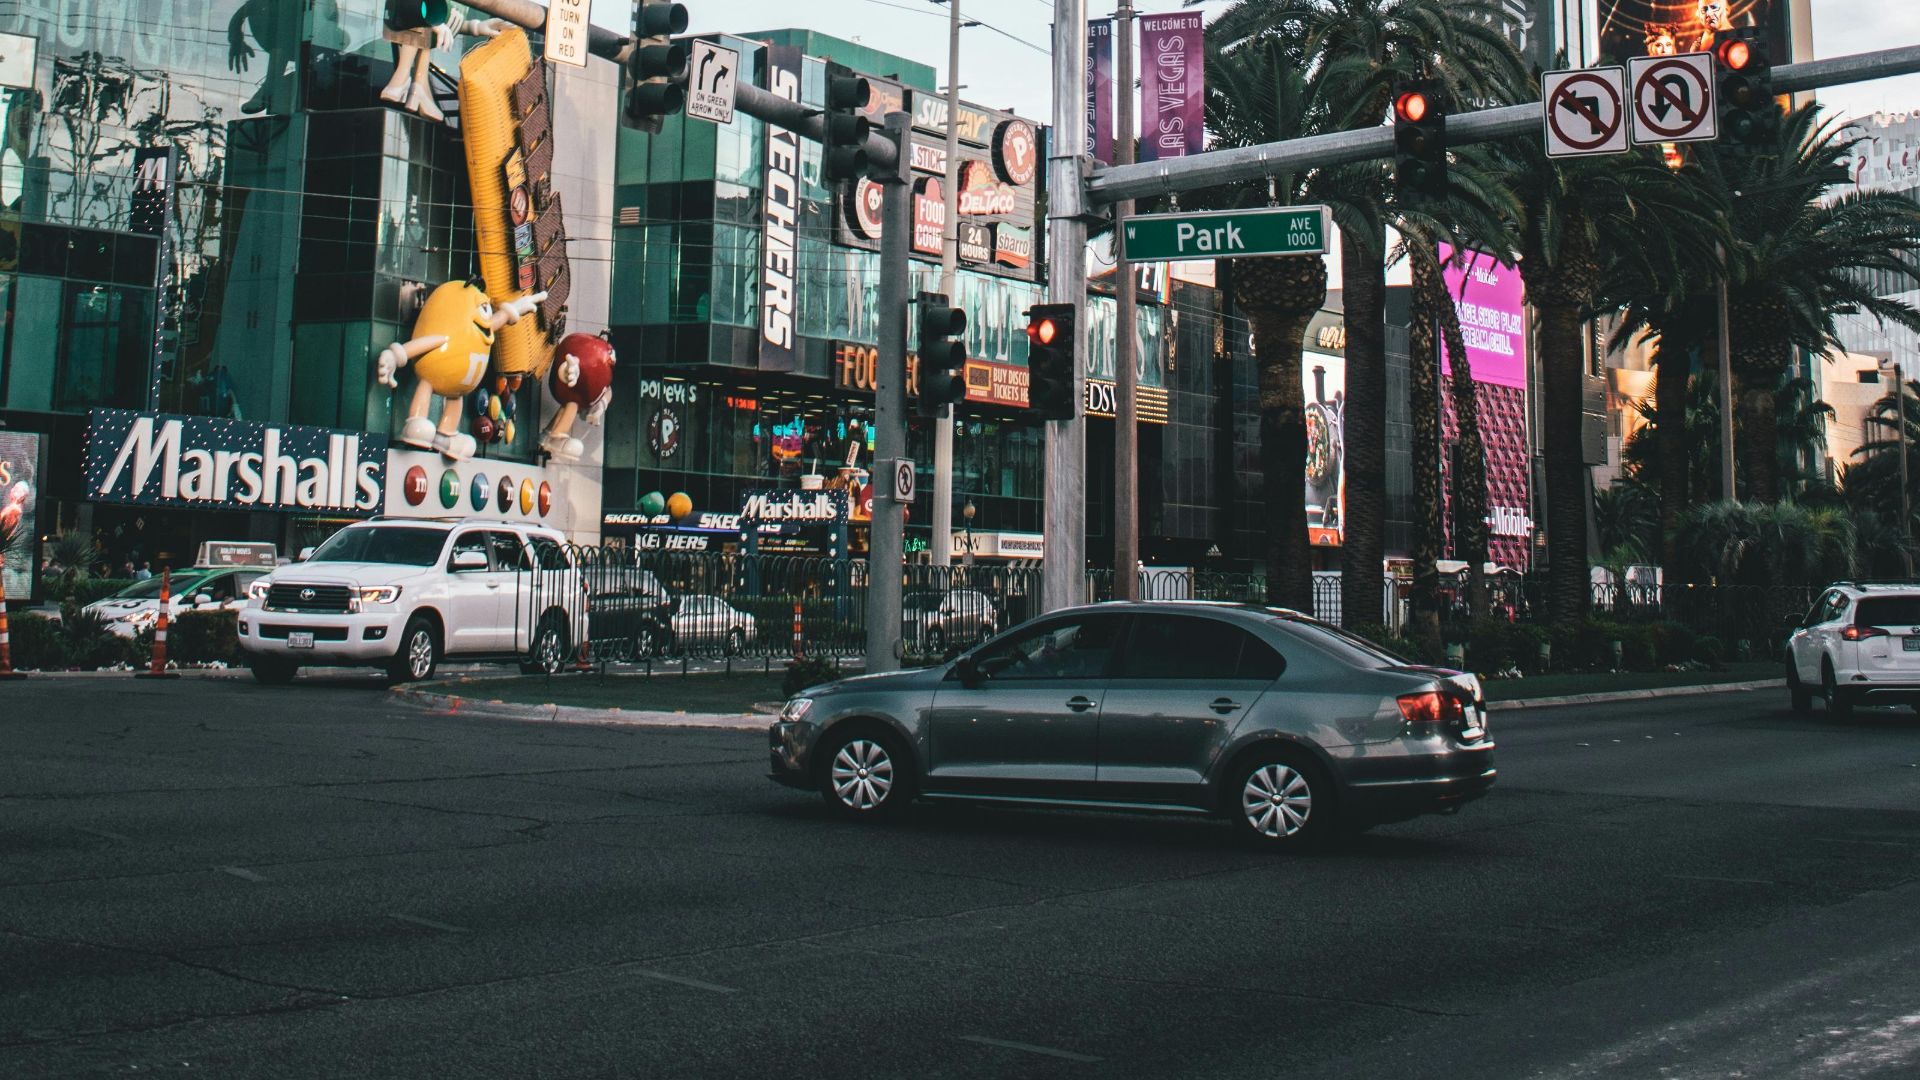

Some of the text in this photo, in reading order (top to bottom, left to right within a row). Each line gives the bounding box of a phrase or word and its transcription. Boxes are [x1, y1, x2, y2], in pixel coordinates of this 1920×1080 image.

[560, 8, 580, 24] TURN
[1144, 17, 1199, 32] WELCOME TO
[563, 26, 574, 40] ON
[1097, 25, 1108, 37] TO
[559, 43, 575, 58] RED
[696, 91, 728, 107] ON GREEN
[1158, 35, 1185, 160] LAS VEGAS
[691, 102, 730, 121] ARROW ONLY
[917, 146, 942, 172] STICK
[1011, 136, 1027, 167] P
[1290, 217, 1311, 231] AVE
[916, 224, 945, 251] COUR
[968, 227, 982, 246] 24
[999, 231, 1029, 255] sbarro
[1127, 220, 1245, 252] W Park
[1287, 231, 1316, 247] 1000
[961, 243, 989, 261] HOURS
[842, 344, 878, 392] FOO
[993, 367, 1008, 384] BUY
[994, 382, 1019, 402] TICKETS
[98, 416, 381, 511] Marshalls
[741, 494, 837, 521] Marshalls
